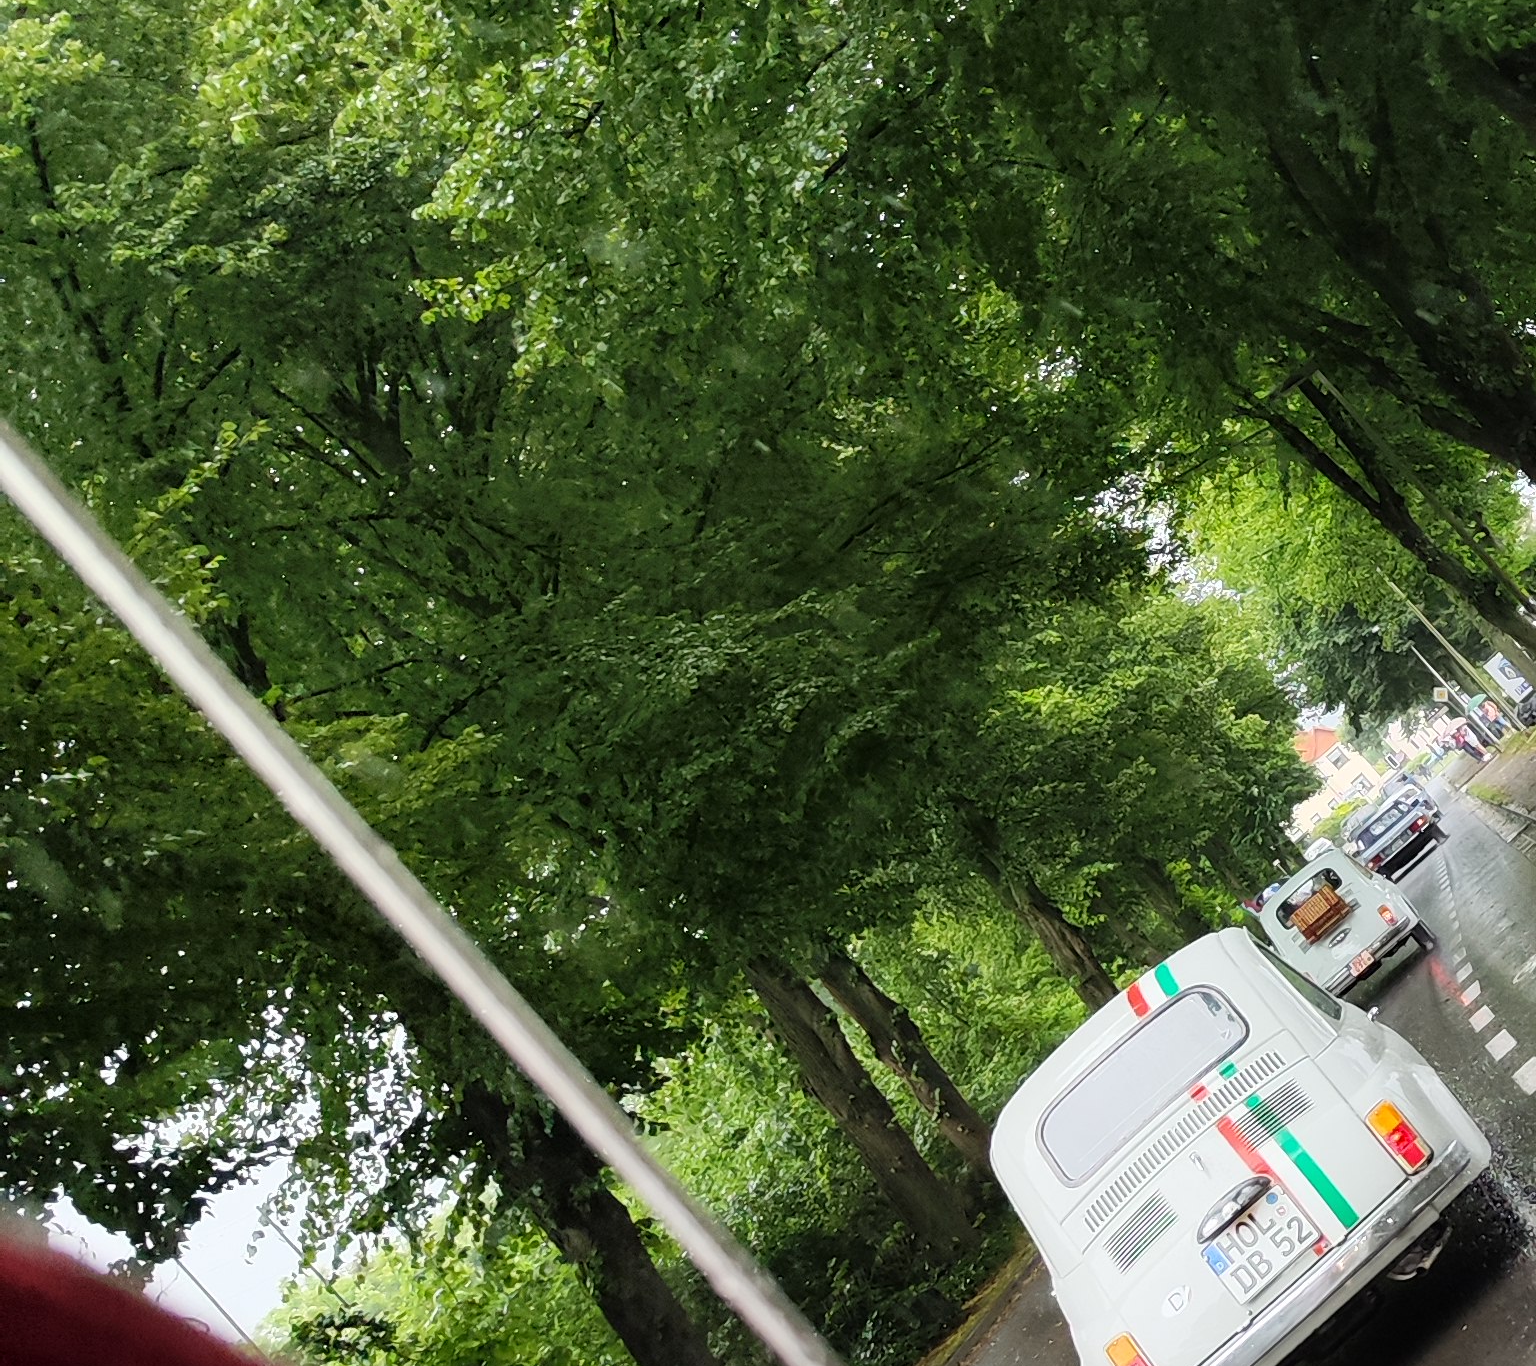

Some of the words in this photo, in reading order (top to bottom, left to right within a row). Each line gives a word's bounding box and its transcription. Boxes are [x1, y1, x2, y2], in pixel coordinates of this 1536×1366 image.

[1216, 1212, 1275, 1263] HOL
[1230, 1250, 1273, 1295] DB
[1269, 1215, 1313, 1258] 52
